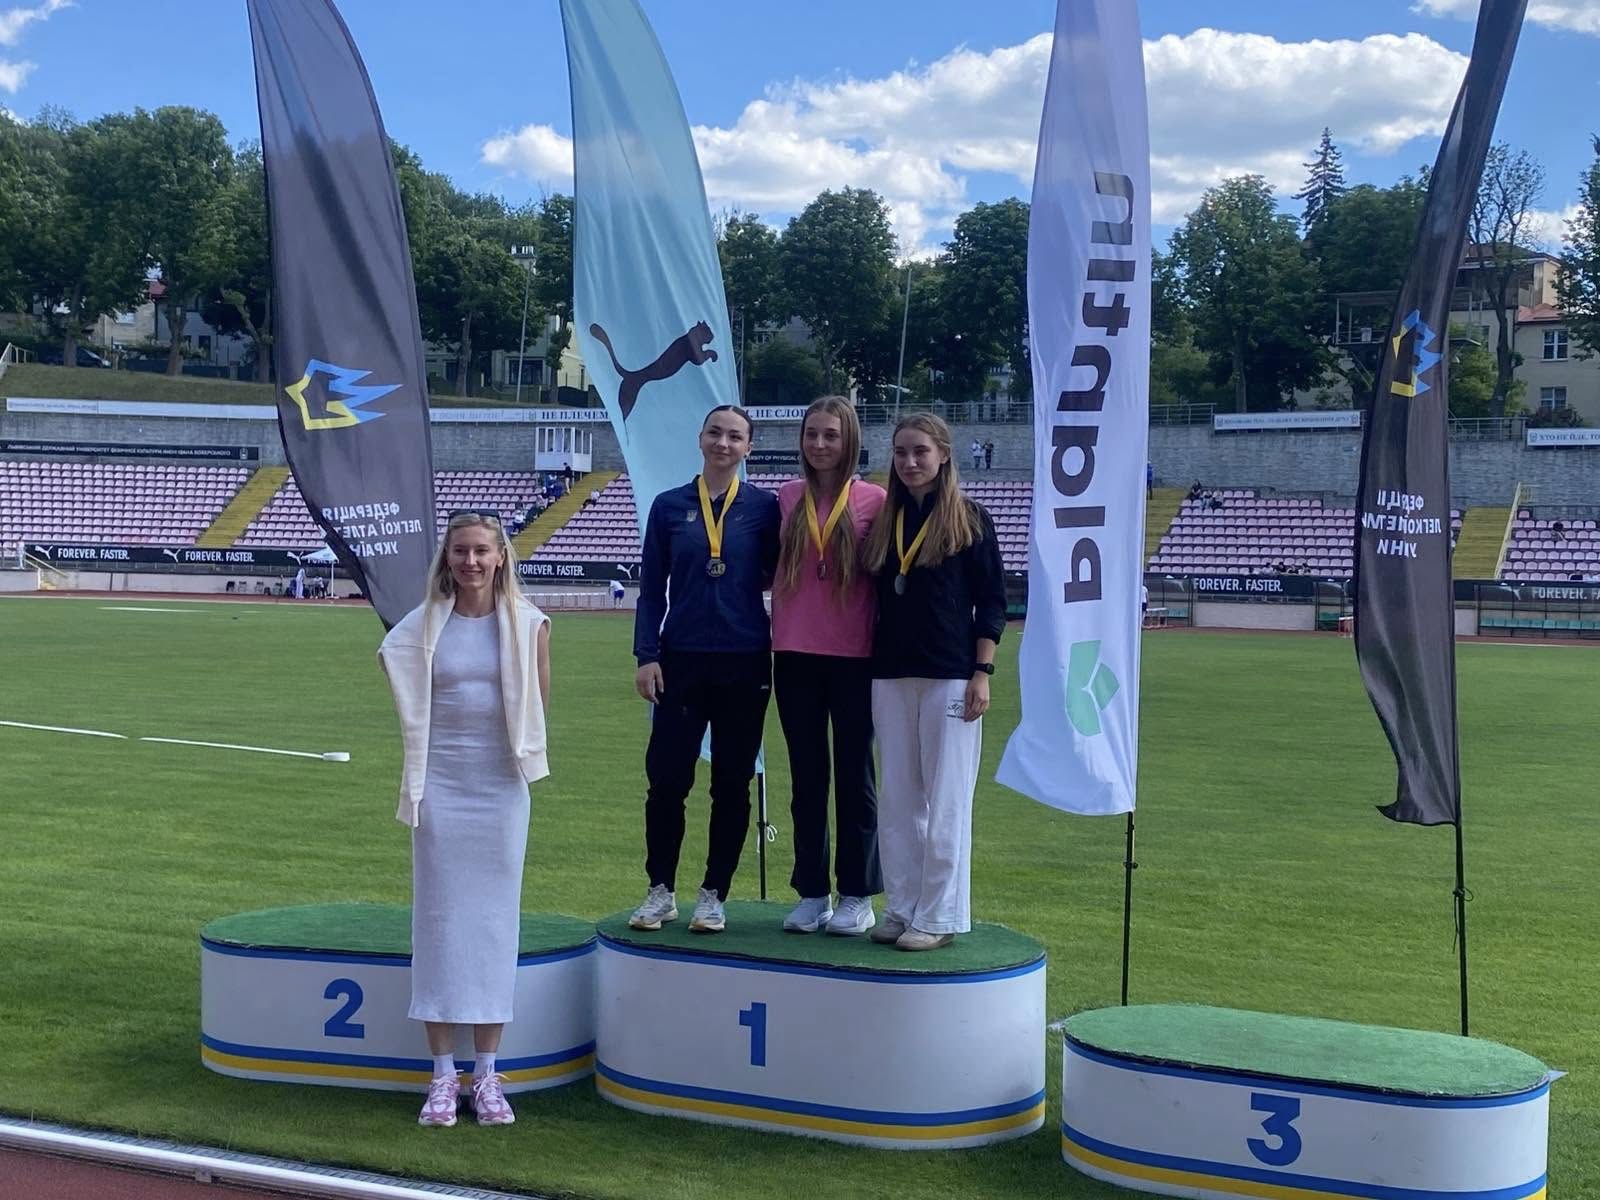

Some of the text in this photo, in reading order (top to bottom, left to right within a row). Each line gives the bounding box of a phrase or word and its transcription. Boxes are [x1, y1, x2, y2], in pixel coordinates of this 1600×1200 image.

[58, 548, 130, 560] FOREVER. FASTER.
[185, 551, 254, 562] FOREVER. FASTER.
[518, 564, 585, 576] FOREVER. FASTER.
[1193, 578, 1283, 592] FOREVER. FASTER.
[323, 978, 365, 1039] 2
[739, 1001, 767, 1067] 1
[1246, 1092, 1302, 1166] 3
